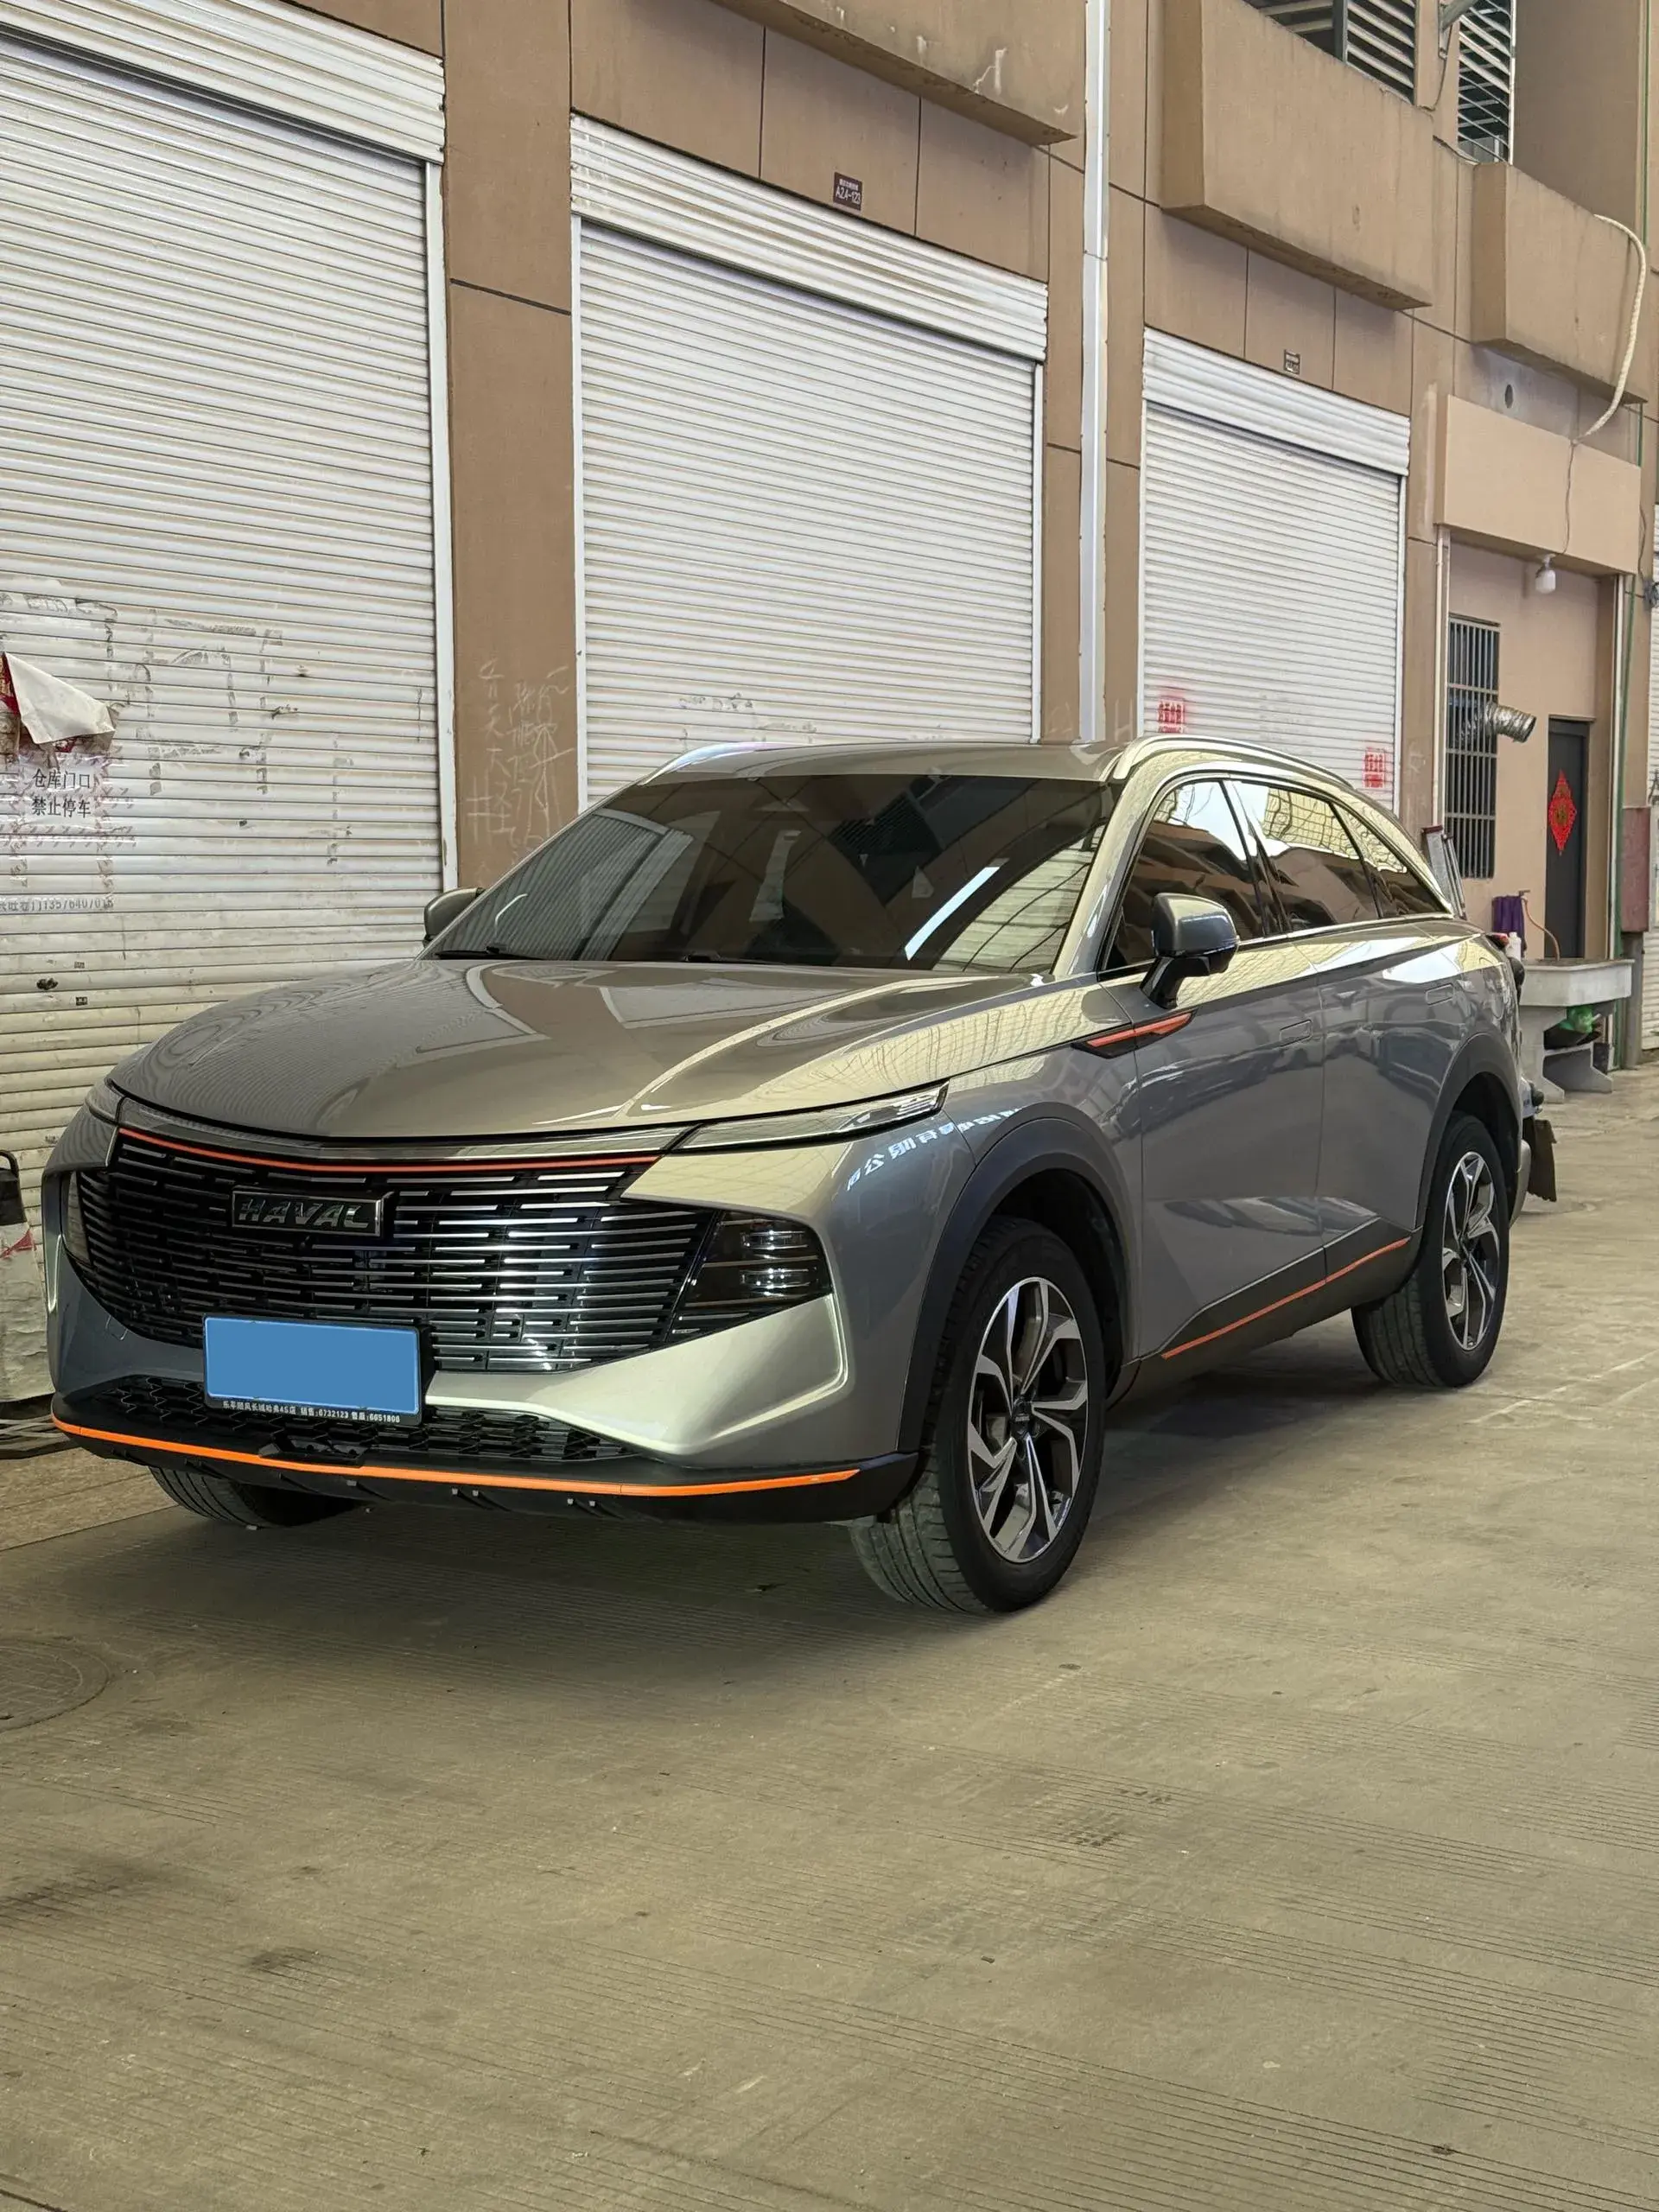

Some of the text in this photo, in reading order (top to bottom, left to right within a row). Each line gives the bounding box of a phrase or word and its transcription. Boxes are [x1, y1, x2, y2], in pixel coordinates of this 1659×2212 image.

[33, 767, 91, 789] 仓库门口
[32, 795, 91, 818] 禁止停车
[238, 1198, 370, 1229] HAVAL
